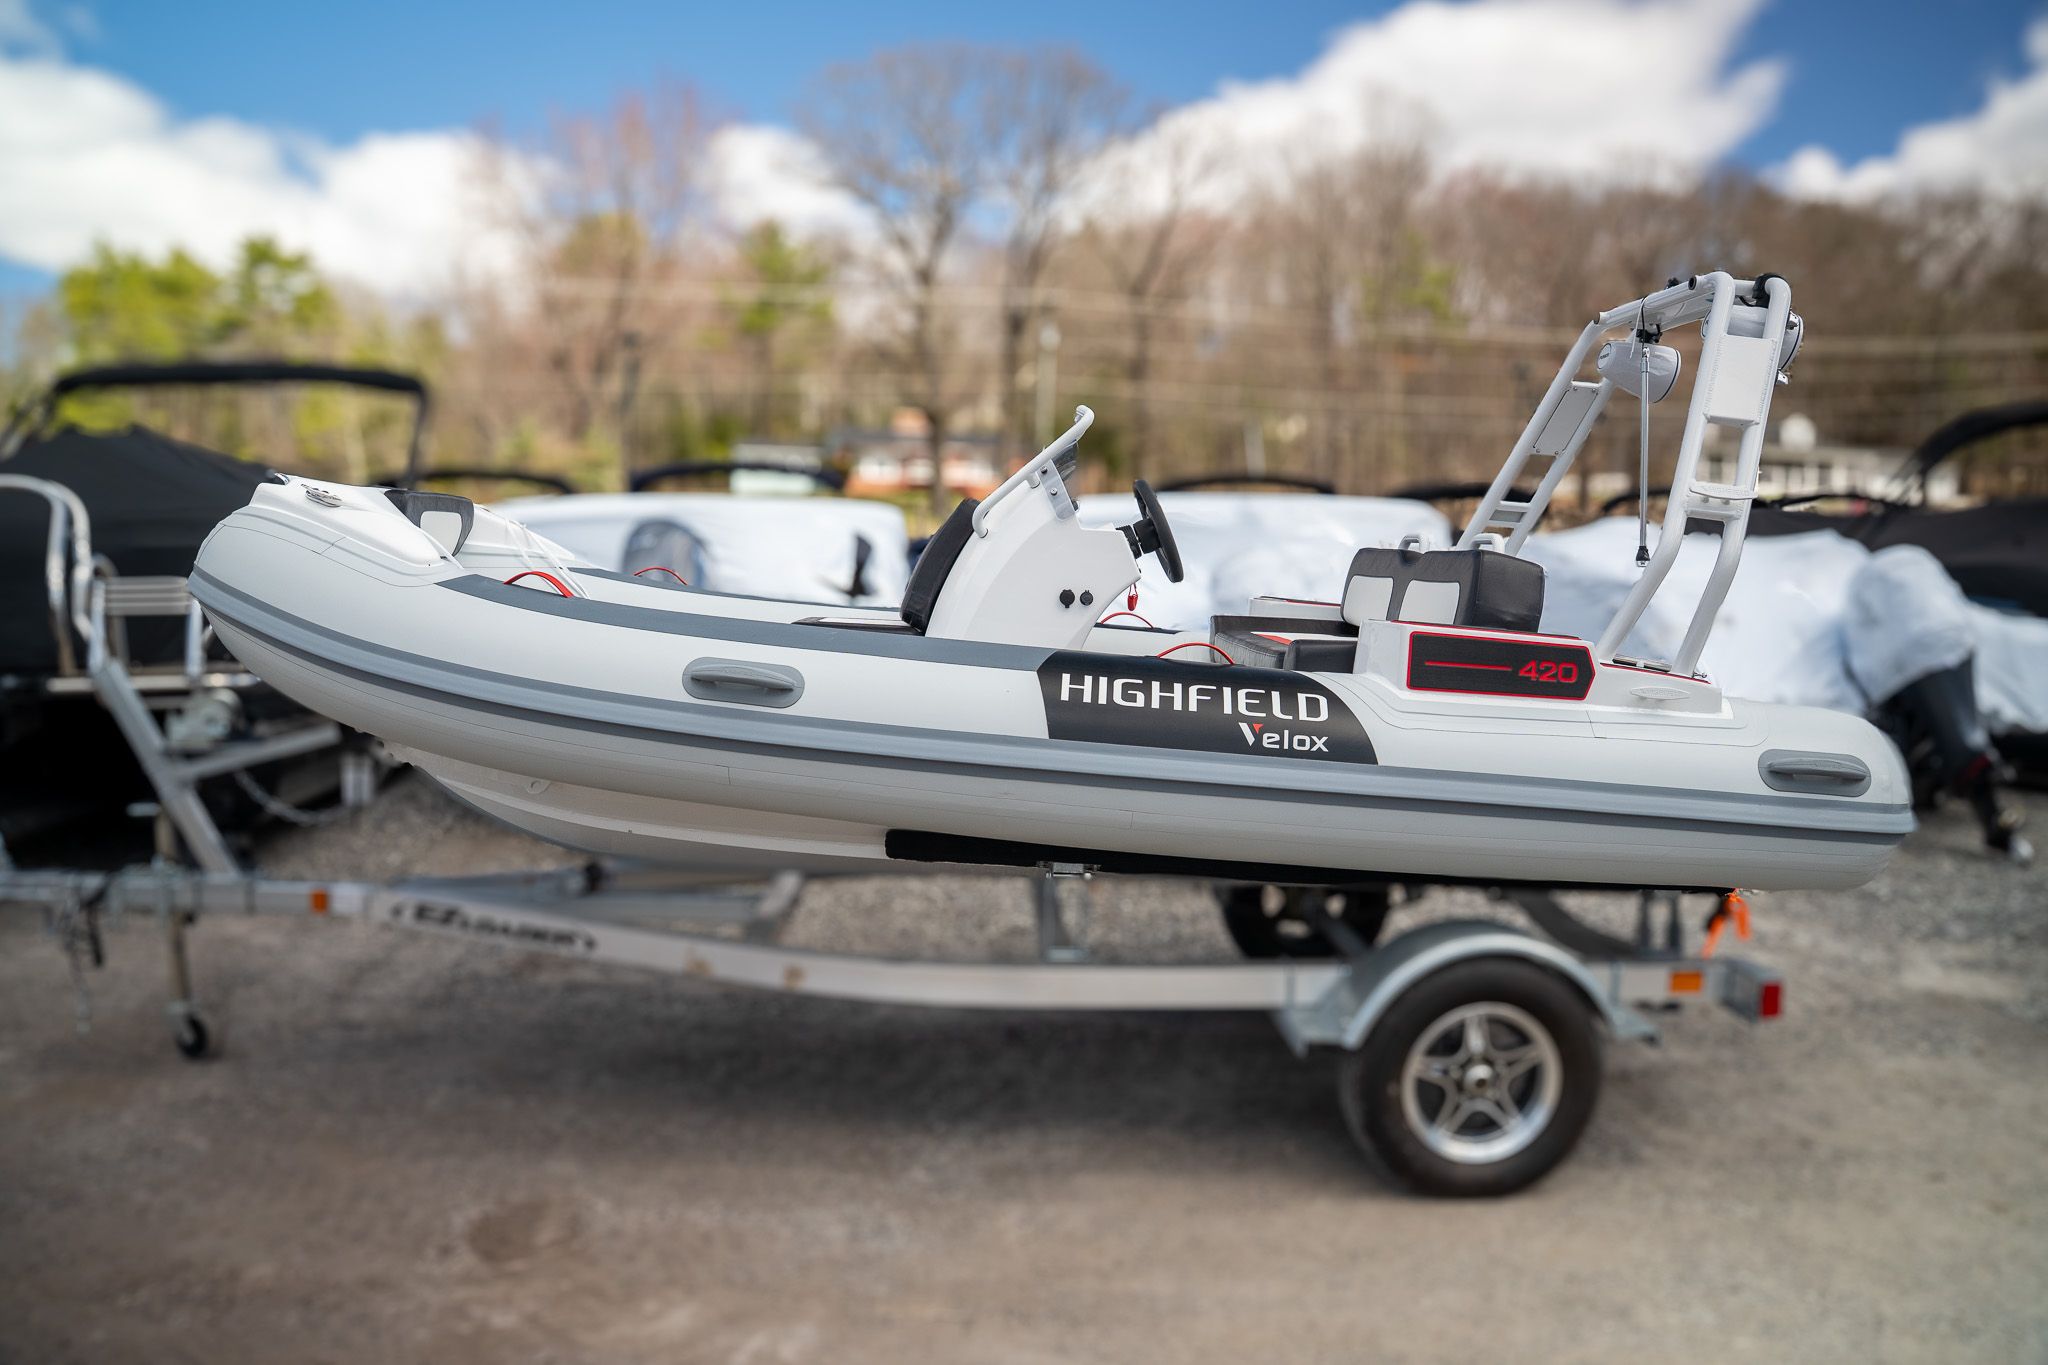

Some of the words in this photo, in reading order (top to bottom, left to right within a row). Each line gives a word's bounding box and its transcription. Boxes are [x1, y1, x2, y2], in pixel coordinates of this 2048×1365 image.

[1518, 660, 1578, 683] 420
[1060, 673, 1329, 721] HIGHFIELD
[1238, 722, 1329, 752] Velox
